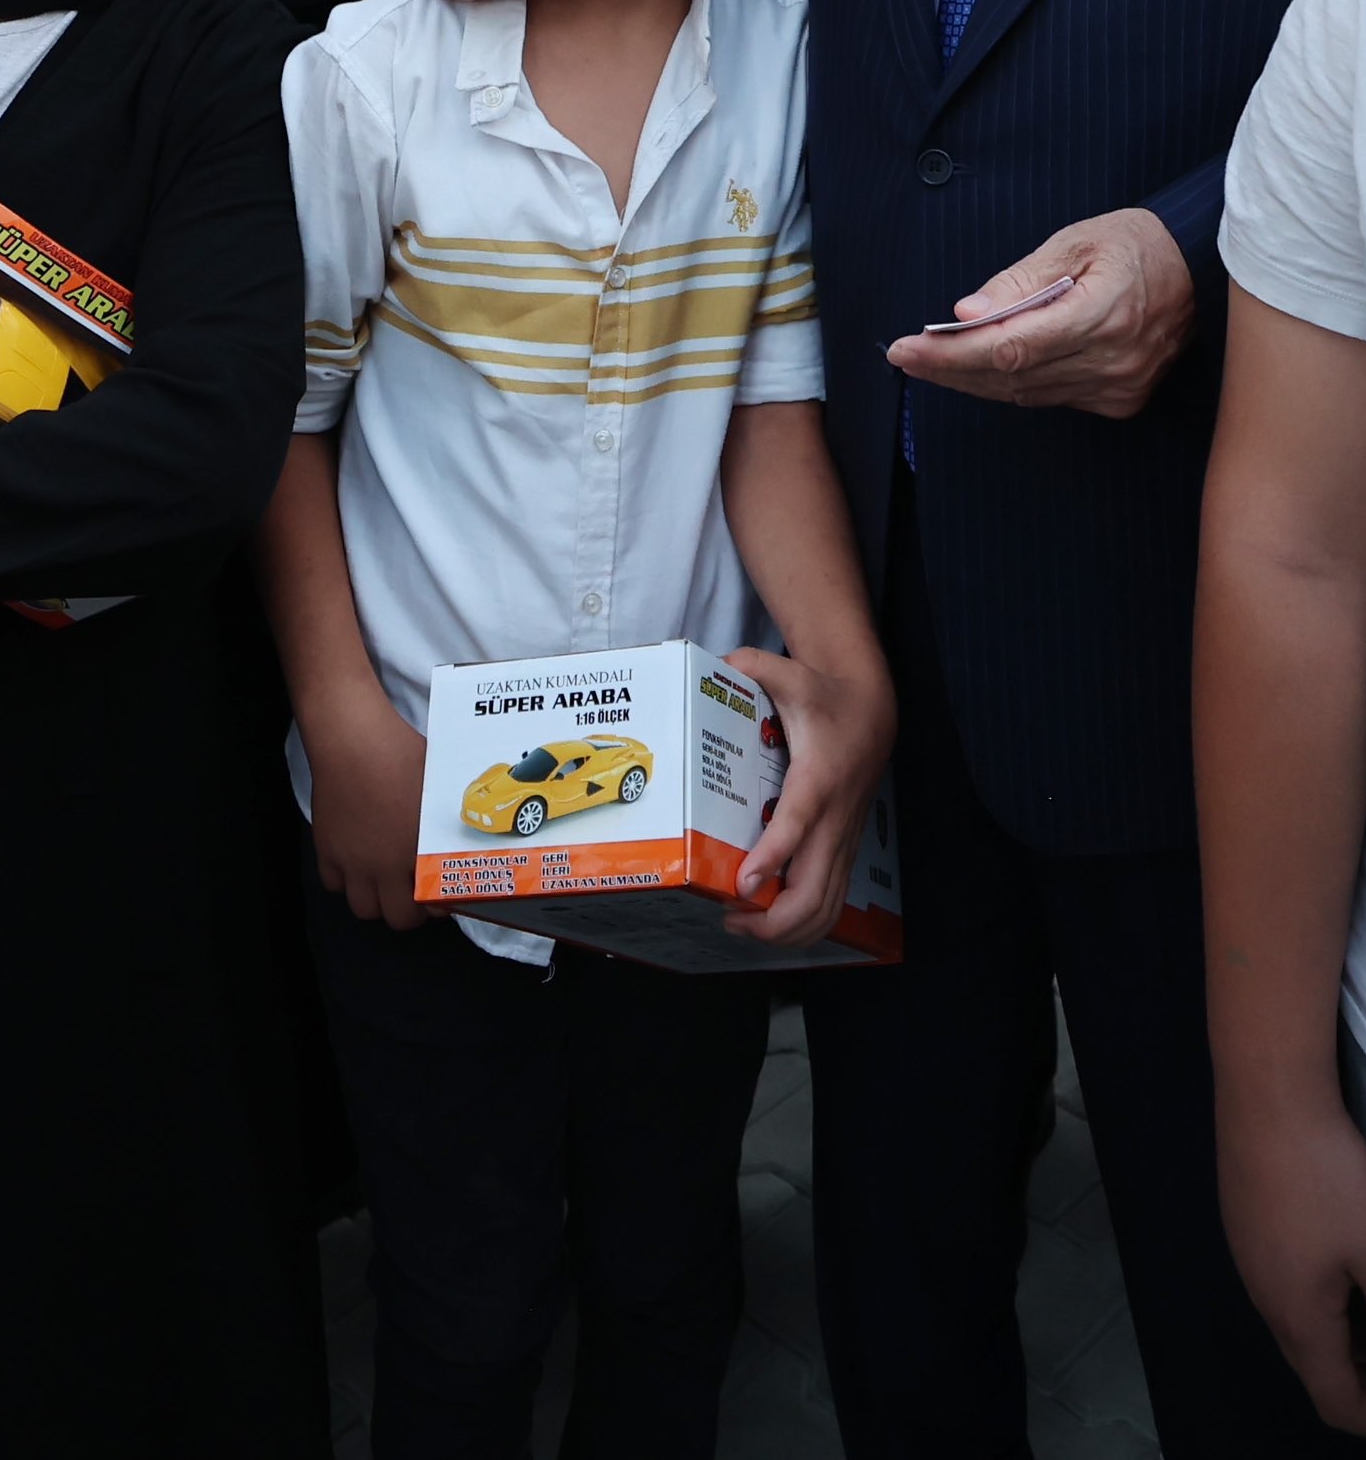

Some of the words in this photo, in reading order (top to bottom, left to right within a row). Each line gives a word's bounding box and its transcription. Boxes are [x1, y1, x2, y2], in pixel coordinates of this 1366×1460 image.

[477, 678, 542, 696] UZAKTAN
[546, 668, 633, 689] KUMANDALI
[475, 695, 545, 717] SÜPER
[552, 687, 632, 710] ARABA
[576, 712, 595, 726] 1:16
[598, 708, 630, 726] ÖLÇEK
[442, 854, 528, 870] FONKSİYONLAR
[542, 850, 569, 863] GERİ
[441, 871, 470, 883] SOLA
[541, 864, 571, 877] İLERİ
[440, 881, 472, 896] SAĞA
[541, 876, 597, 891] UZAKTAN
[600, 873, 661, 887] KUMANDA
